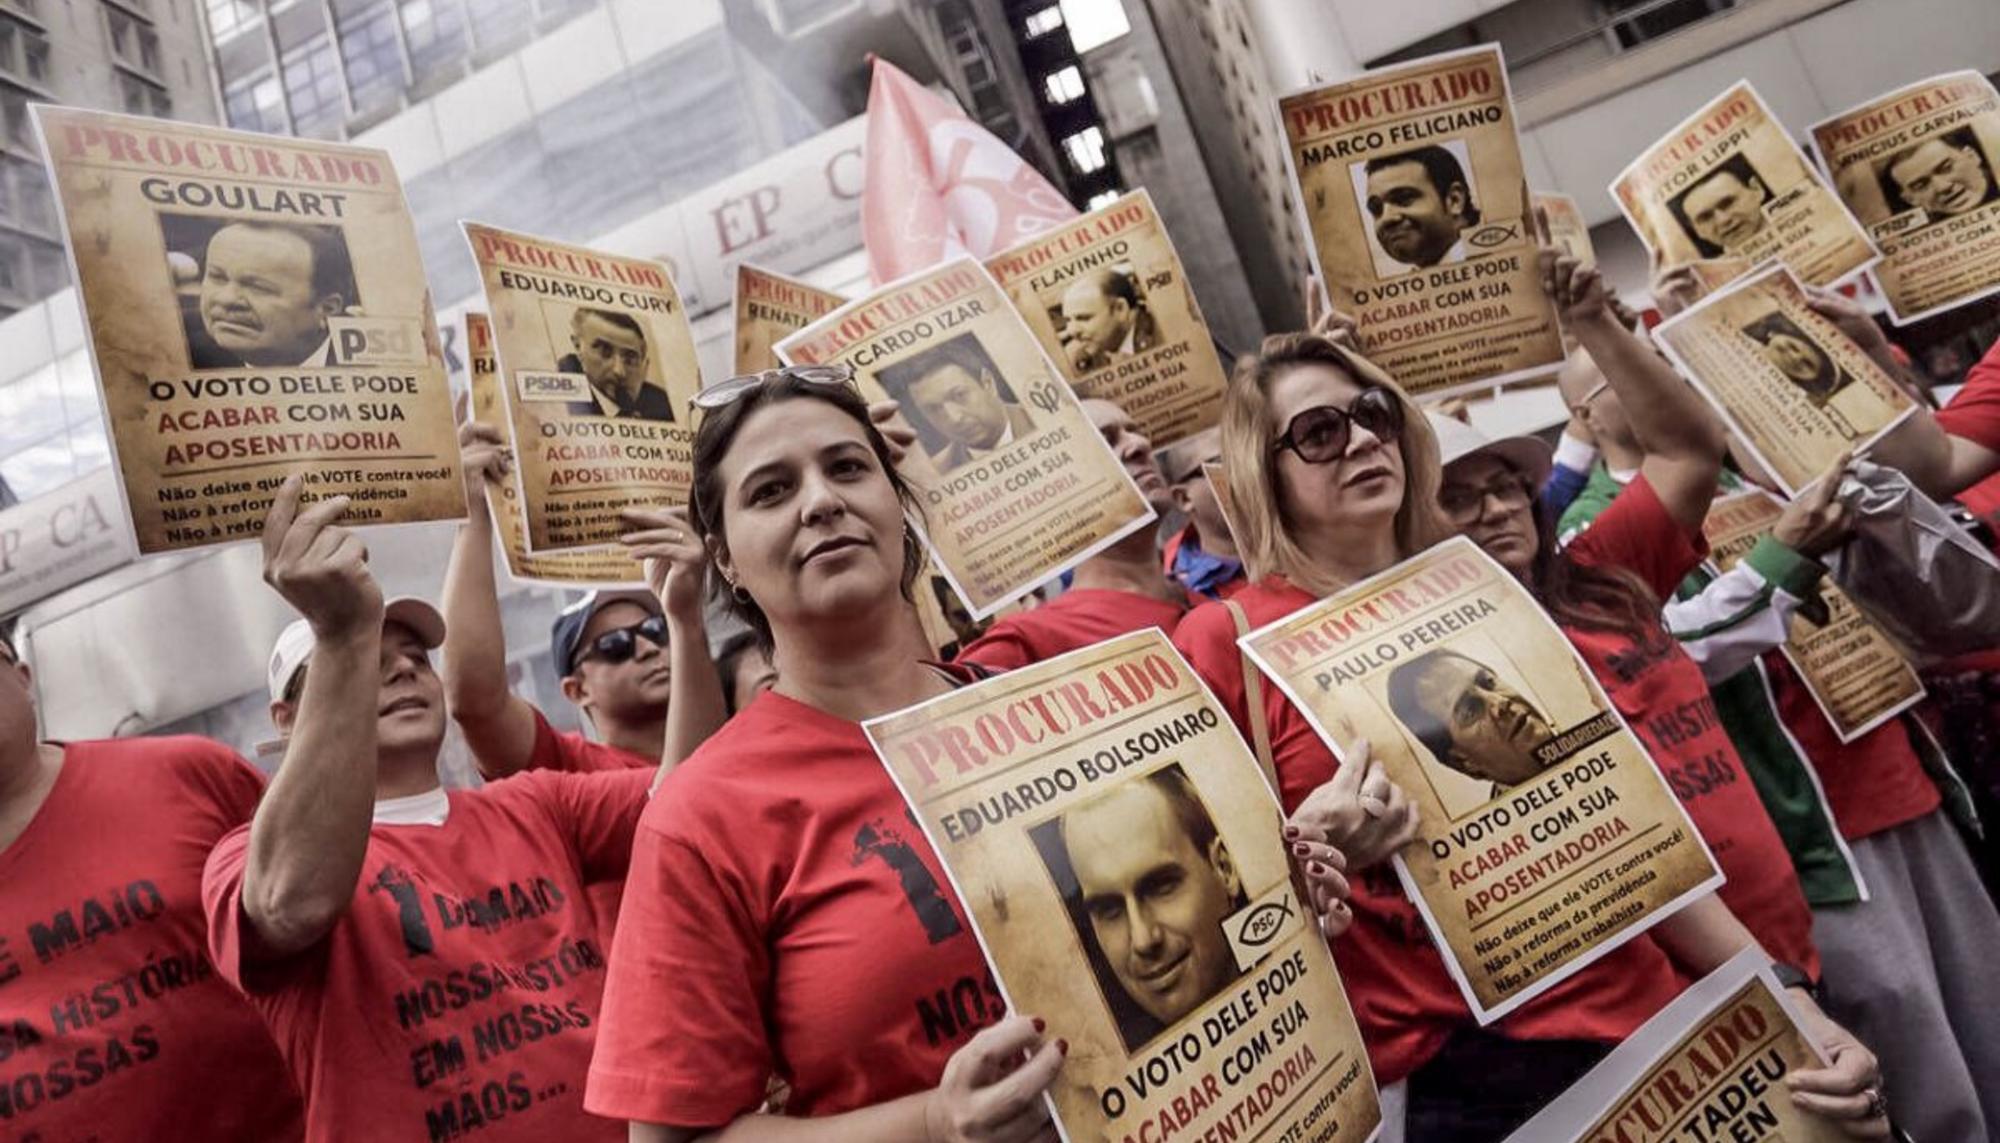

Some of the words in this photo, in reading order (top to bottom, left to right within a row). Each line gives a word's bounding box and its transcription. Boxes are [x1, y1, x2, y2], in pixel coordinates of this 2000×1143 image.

[1291, 66, 1491, 137] PROCURADO
[61, 124, 382, 186] PROCURADO
[1302, 131, 1383, 167] MARCO
[1389, 105, 1502, 143] FELICIANO
[1704, 128, 1750, 167] LIPPI
[140, 178, 347, 218] GOULART
[479, 233, 663, 289] PROCURADO
[993, 204, 1145, 281] PROCURADO
[1029, 239, 1129, 294] FLAVINHO
[500, 270, 614, 305] EDUARDO
[619, 292, 673, 315] CURY
[1354, 288, 1369, 305] O
[1372, 275, 1425, 301] VOTO
[1430, 266, 1472, 289] DELE
[1474, 256, 1519, 279] PODE
[1361, 300, 1431, 327] ACABAR
[1435, 288, 1475, 310] COM
[1480, 281, 1511, 299] SUA
[797, 266, 978, 363] PROCURADO
[936, 299, 987, 331] IZAR
[1365, 304, 1511, 349] APOSENTADORIA
[150, 380, 175, 401] O
[183, 377, 271, 398] VOTO
[280, 374, 346, 395] DELE
[353, 375, 418, 395] PODE
[1117, 357, 1150, 378] DELE
[1153, 340, 1191, 363] PODE
[1125, 373, 1157, 394] COM
[1160, 361, 1188, 379] SUA
[157, 406, 279, 434] ACABAR
[288, 404, 351, 423] COM
[358, 404, 405, 421] SUA
[165, 431, 402, 466] APOSENTADORIA
[541, 423, 557, 438] O
[560, 422, 614, 438] VOTO
[619, 423, 658, 441] DELE
[158, 487, 196, 503] Não
[203, 481, 250, 498] deixe
[322, 469, 363, 484] VOTE
[366, 469, 414, 482] contra
[416, 466, 452, 480] você!
[546, 445, 621, 462] ACABAR
[626, 445, 663, 461] COM
[550, 467, 693, 486] APOSENTADORIA
[928, 489, 943, 504] O
[943, 468, 990, 497] VOTO
[990, 447, 1030, 475] DELE
[1029, 426, 1073, 456] PODE
[162, 506, 199, 523] Não
[207, 502, 218, 518] à
[301, 490, 319, 503] da
[942, 488, 1002, 526] ACABAR
[1004, 465, 1043, 493] COM
[1043, 450, 1074, 477] SUA
[955, 473, 1081, 547] APOSENTADORIA
[167, 527, 206, 544] Não
[210, 523, 221, 539] à
[1266, 557, 1484, 671] PROCURADO
[1314, 643, 1399, 693] PAULO
[1399, 597, 1498, 651] PEREIRA
[900, 652, 1181, 792] PROCURADO
[939, 766, 1079, 844] EDUARDO
[1080, 705, 1221, 783] BOLSONARO
[1432, 839, 1449, 861] O
[1451, 809, 1511, 851] VOTO
[1512, 783, 1560, 819] DELE
[1562, 751, 1617, 791] PODE
[1448, 832, 1531, 891] ACABAR
[1531, 810, 1582, 845] COM
[1584, 786, 1620, 822] SUA
[1462, 816, 1631, 921] APOSENTADORIA
[27, 879, 166, 965] MAIO
[1474, 936, 1502, 957] Não
[1503, 916, 1537, 942] deixe
[1538, 903, 1562, 923] que
[1562, 890, 1582, 907] ele
[1579, 868, 1614, 896] VOTE
[1614, 852, 1654, 877] contra
[1652, 828, 1686, 856] você!
[1483, 955, 1512, 976] Não
[1514, 947, 1522, 962] à
[1523, 921, 1573, 957] reforma
[1572, 910, 1589, 926] da
[1590, 869, 1658, 918] previdência
[1250, 910, 1276, 940] PSC
[1494, 974, 1521, 994] Não
[1523, 964, 1533, 980] à
[1532, 938, 1581, 974] reforma
[1582, 900, 1646, 942] trabalhista
[51, 953, 213, 1036] HISTÓRIA
[410, 1035, 466, 1089] EM
[472, 1001, 592, 1064] NOSSAS
[1101, 1087, 1126, 1119] O
[1125, 1032, 1201, 1101] VOTO
[1202, 990, 1259, 1048] DELE
[1257, 949, 1309, 1010] PODE
[1222, 1030, 1273, 1086] COM
[1271, 1000, 1310, 1046] SUA
[1302, 1090, 1338, 1131] contra
[1335, 1060, 1362, 1095] você!
